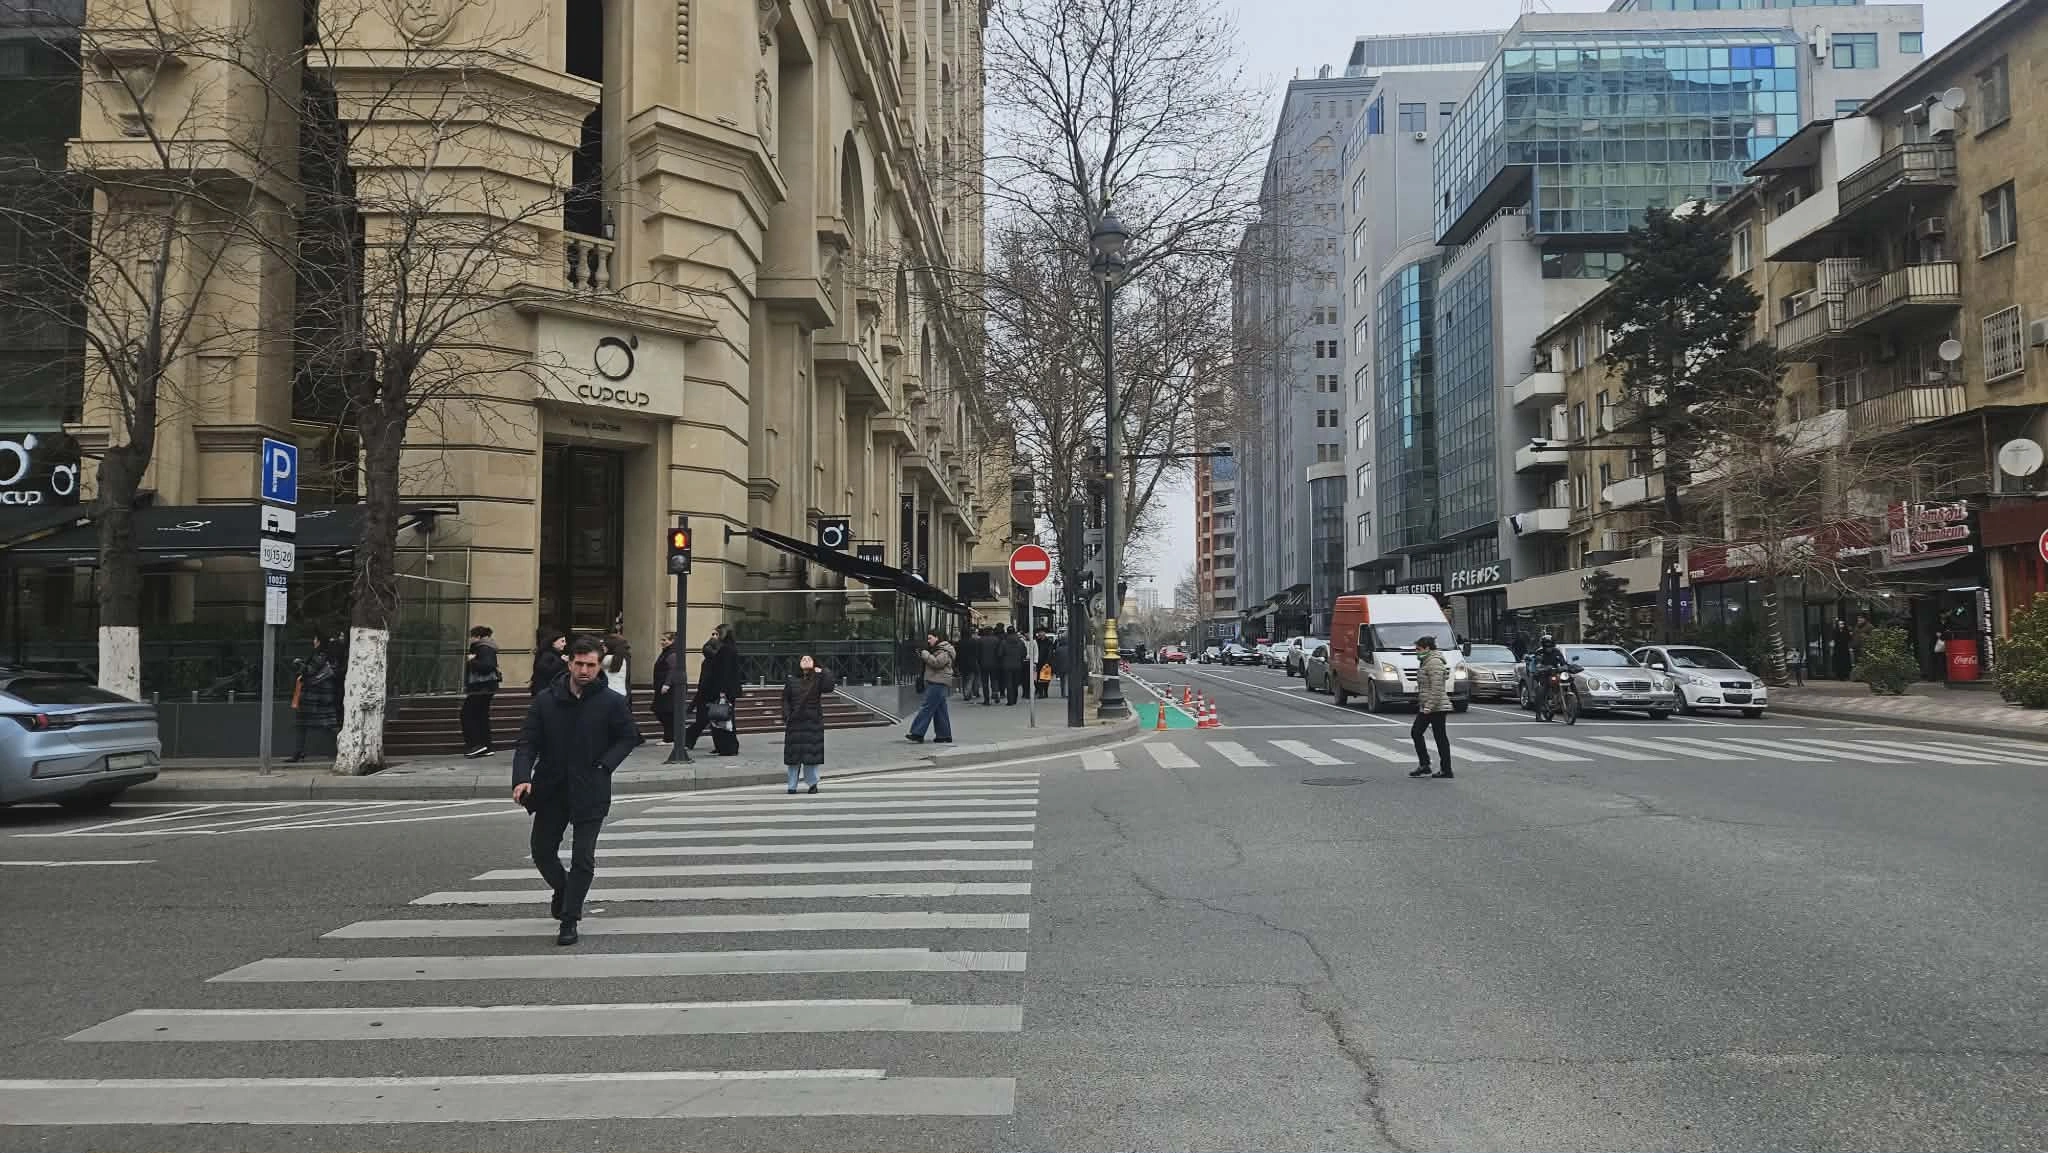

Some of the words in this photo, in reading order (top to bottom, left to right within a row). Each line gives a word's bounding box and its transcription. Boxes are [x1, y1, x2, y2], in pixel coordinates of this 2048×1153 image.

[273, 448, 291, 493] P
[273, 550, 280, 560] 15
[283, 552, 291, 562] 20
[1451, 565, 1501, 589] FRIENDS
[1411, 583, 1442, 594] CENTER
